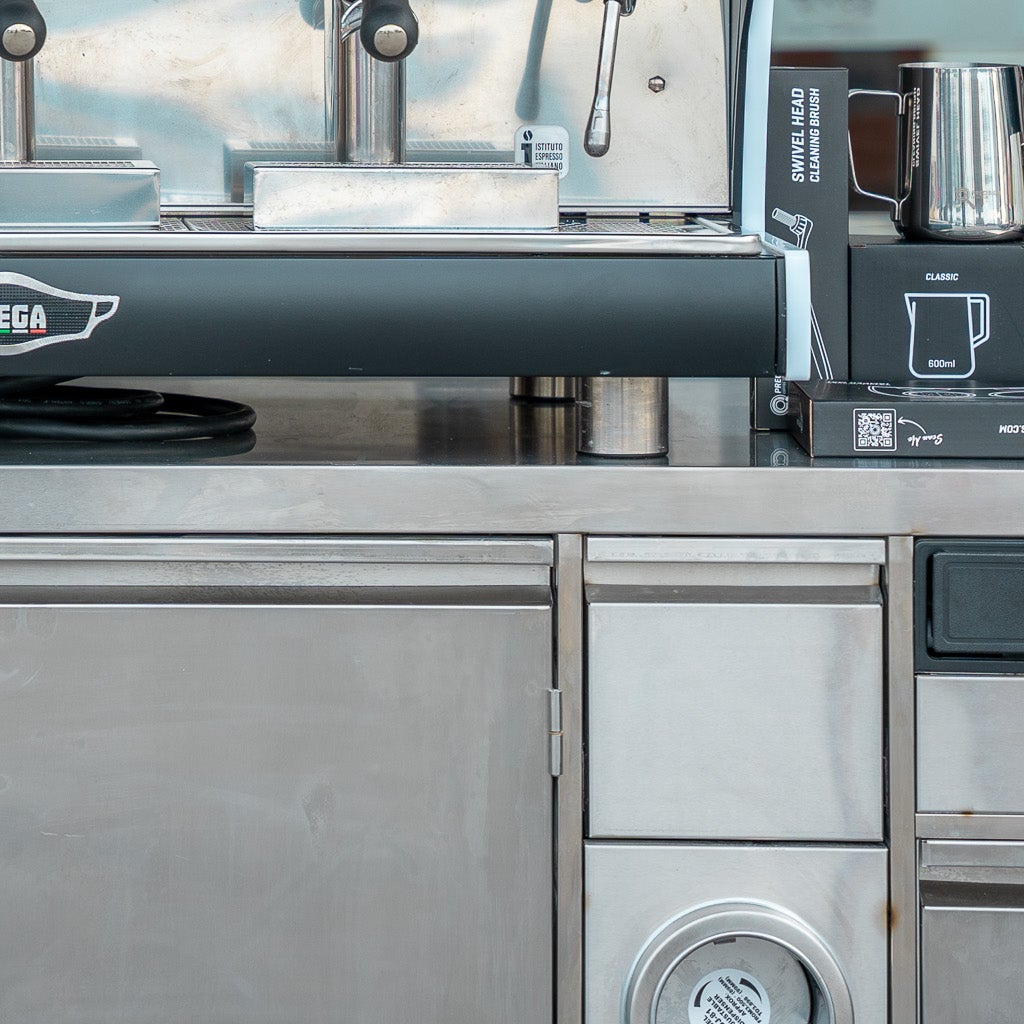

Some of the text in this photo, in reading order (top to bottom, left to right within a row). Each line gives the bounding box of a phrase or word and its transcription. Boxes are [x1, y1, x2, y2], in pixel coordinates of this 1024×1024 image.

[792, 88, 804, 182] SWIVEL HEAD
[809, 88, 820, 183] CLEANING BRUSH
[535, 142, 562, 151] ISTITUTO
[928, 359, 956, 368] 600ml
[922, 433, 944, 446] Scan
